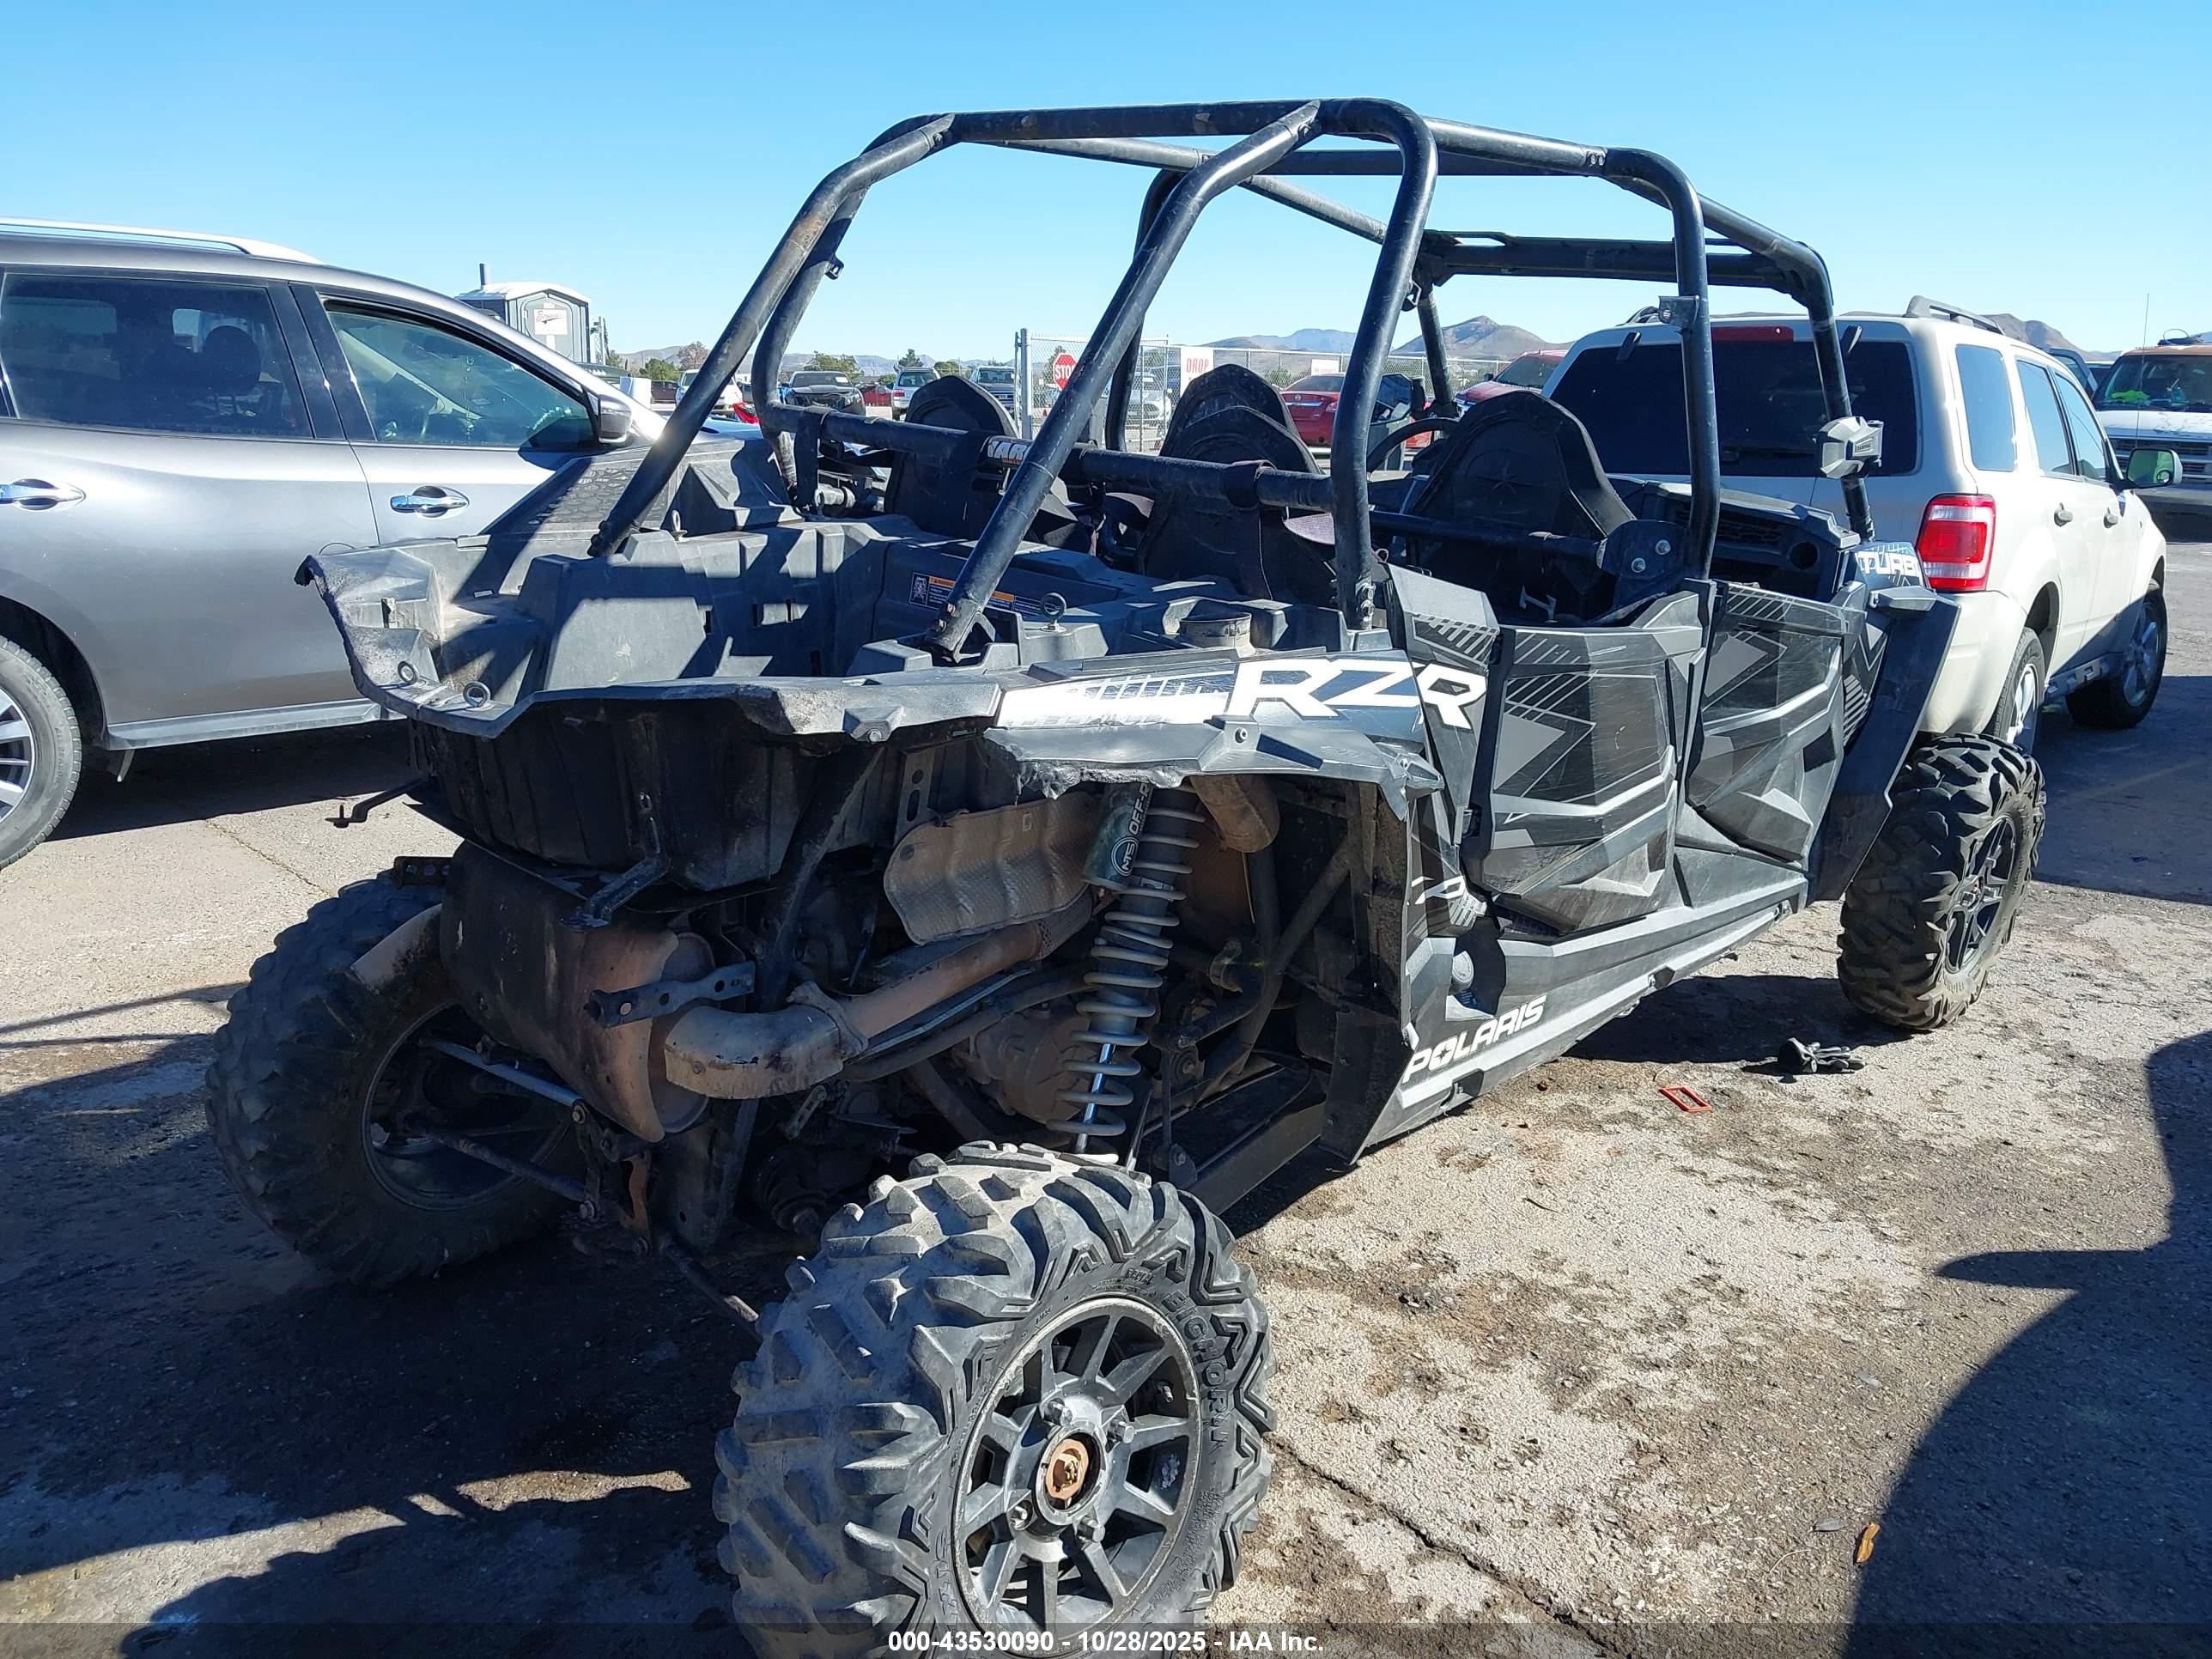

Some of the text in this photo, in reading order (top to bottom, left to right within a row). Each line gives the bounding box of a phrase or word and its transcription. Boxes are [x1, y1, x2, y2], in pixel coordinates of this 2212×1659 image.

[1186, 357, 1209, 374] DROP
[1224, 657, 1487, 730] RZR
[1401, 994, 1547, 1084] POLARIS
